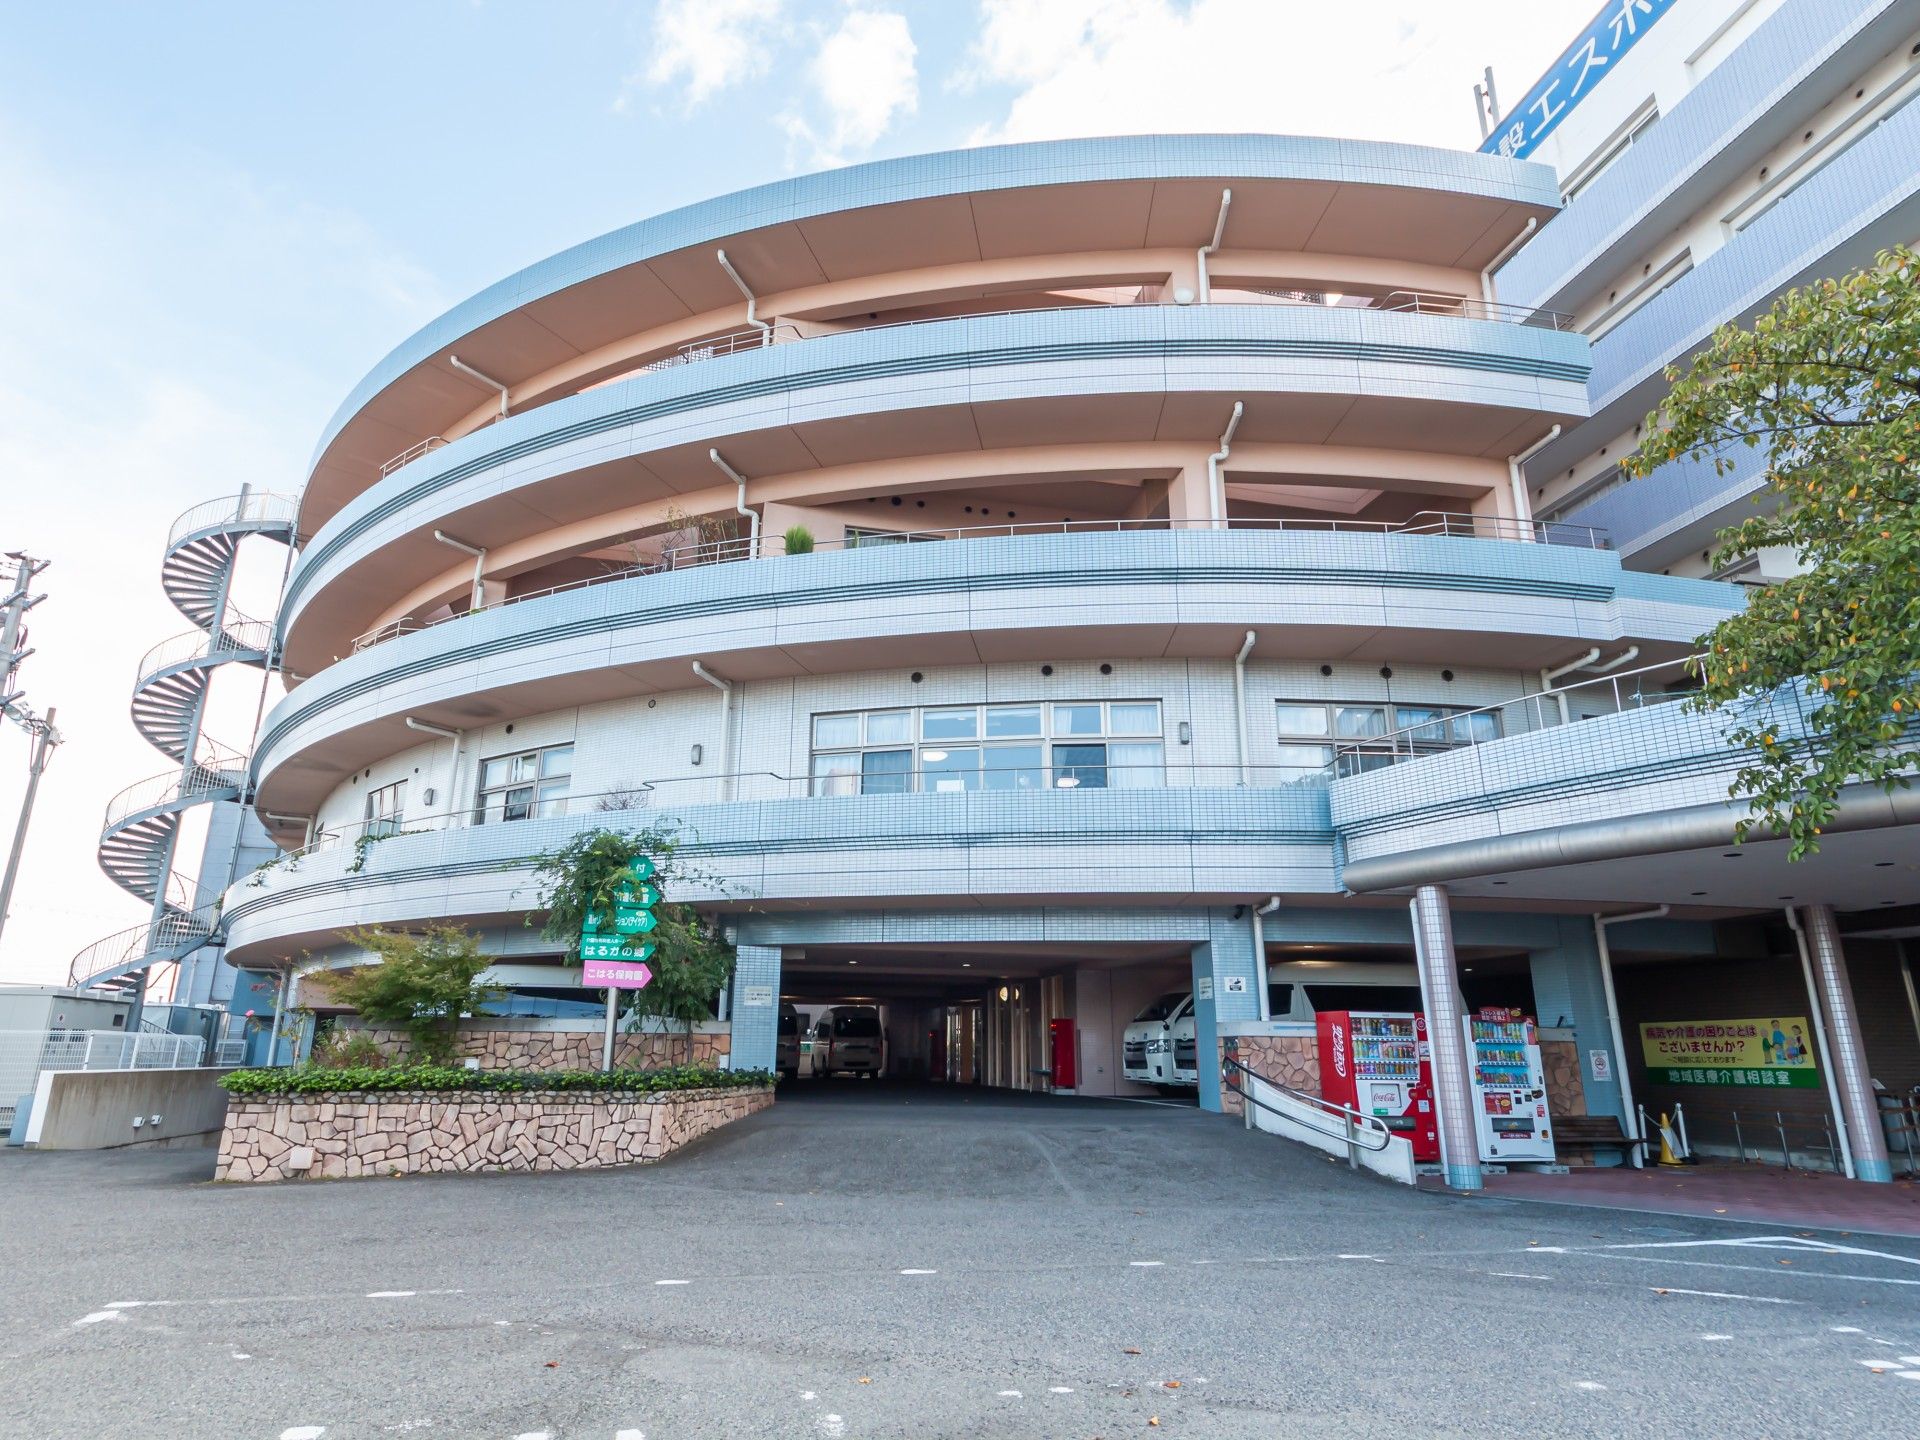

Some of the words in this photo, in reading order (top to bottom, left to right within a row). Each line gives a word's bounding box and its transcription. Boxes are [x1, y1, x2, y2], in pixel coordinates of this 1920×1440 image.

[584, 945, 645, 957] はるかの郷
[587, 968, 643, 981] こはる保育園
[1331, 1022, 1347, 1078] Coca-Cola
[1668, 1069, 1791, 1085] 地域医療介護相談室
